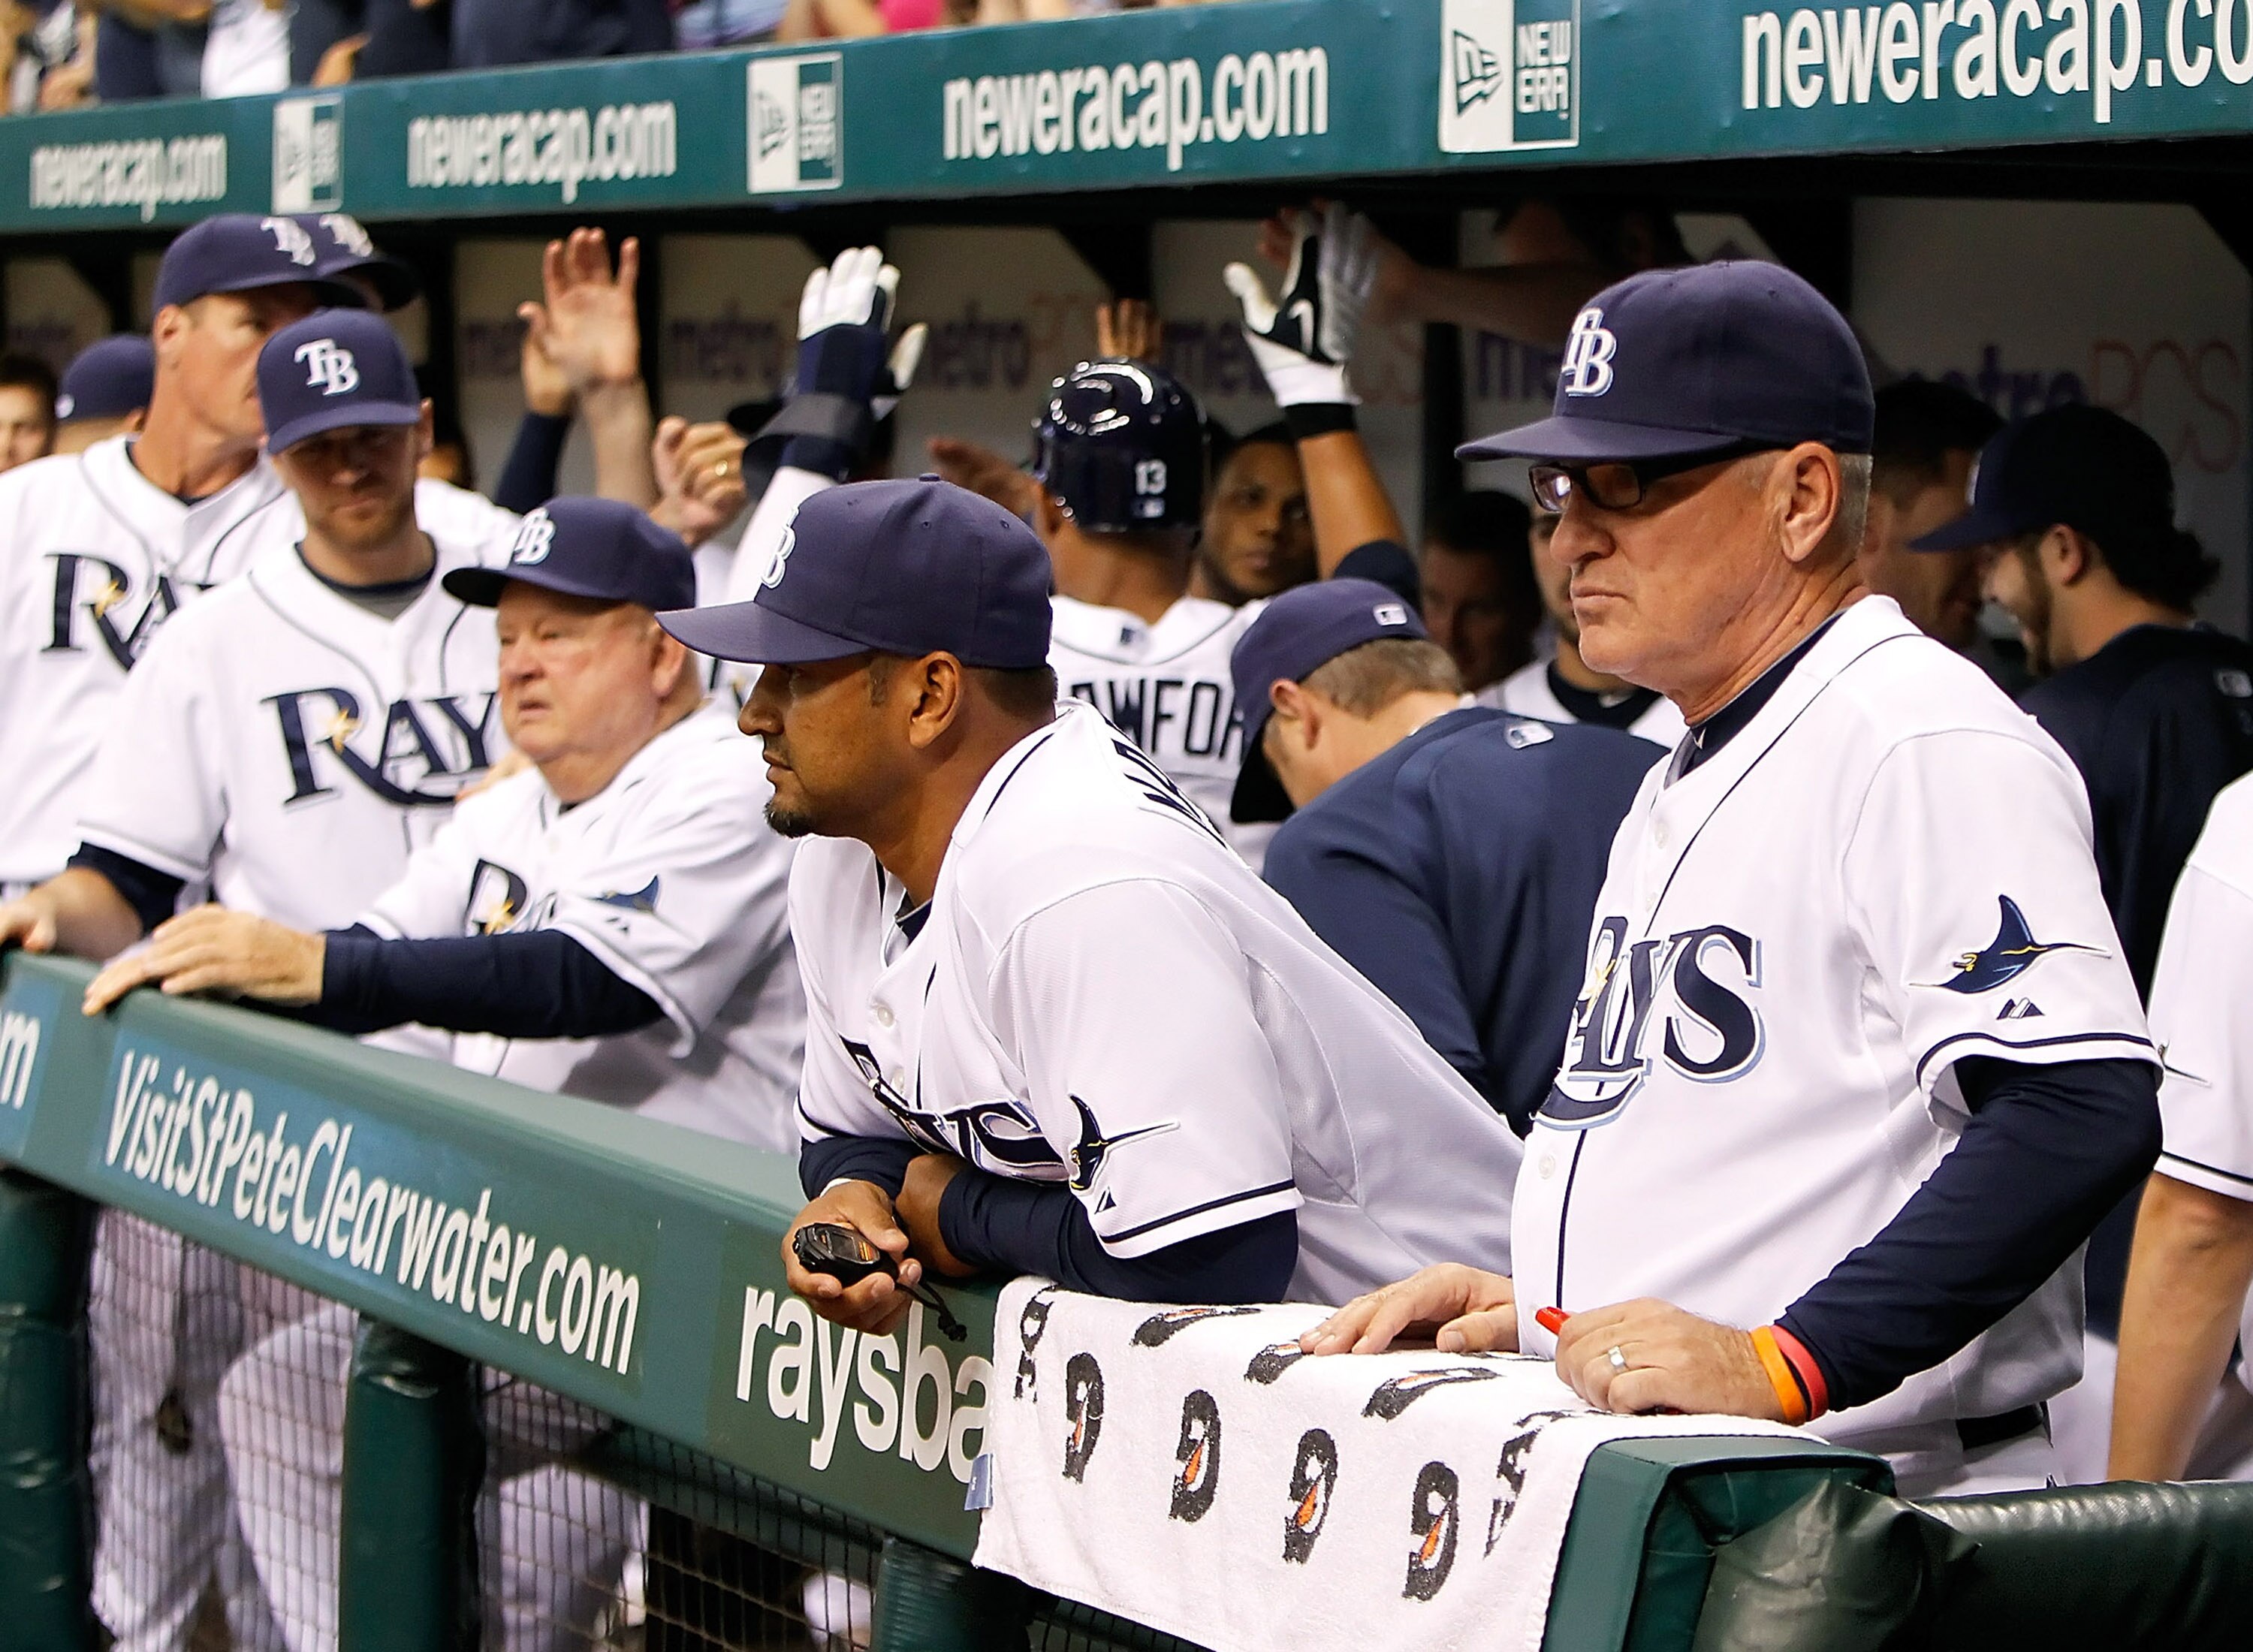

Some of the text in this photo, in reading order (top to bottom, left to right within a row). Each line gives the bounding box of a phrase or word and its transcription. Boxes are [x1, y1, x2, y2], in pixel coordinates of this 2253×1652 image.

[1516, 20, 1571, 69] NEW
[943, 45, 1329, 172] neweracap.com
[1516, 66, 1570, 113] ERA
[29, 134, 227, 223] neweracap.com
[406, 99, 677, 204] neweracap.com
[294, 339, 360, 396] TB
[1135, 459, 1166, 496] 13
[104, 1048, 641, 1376] VisitStPeteClearwater.com
